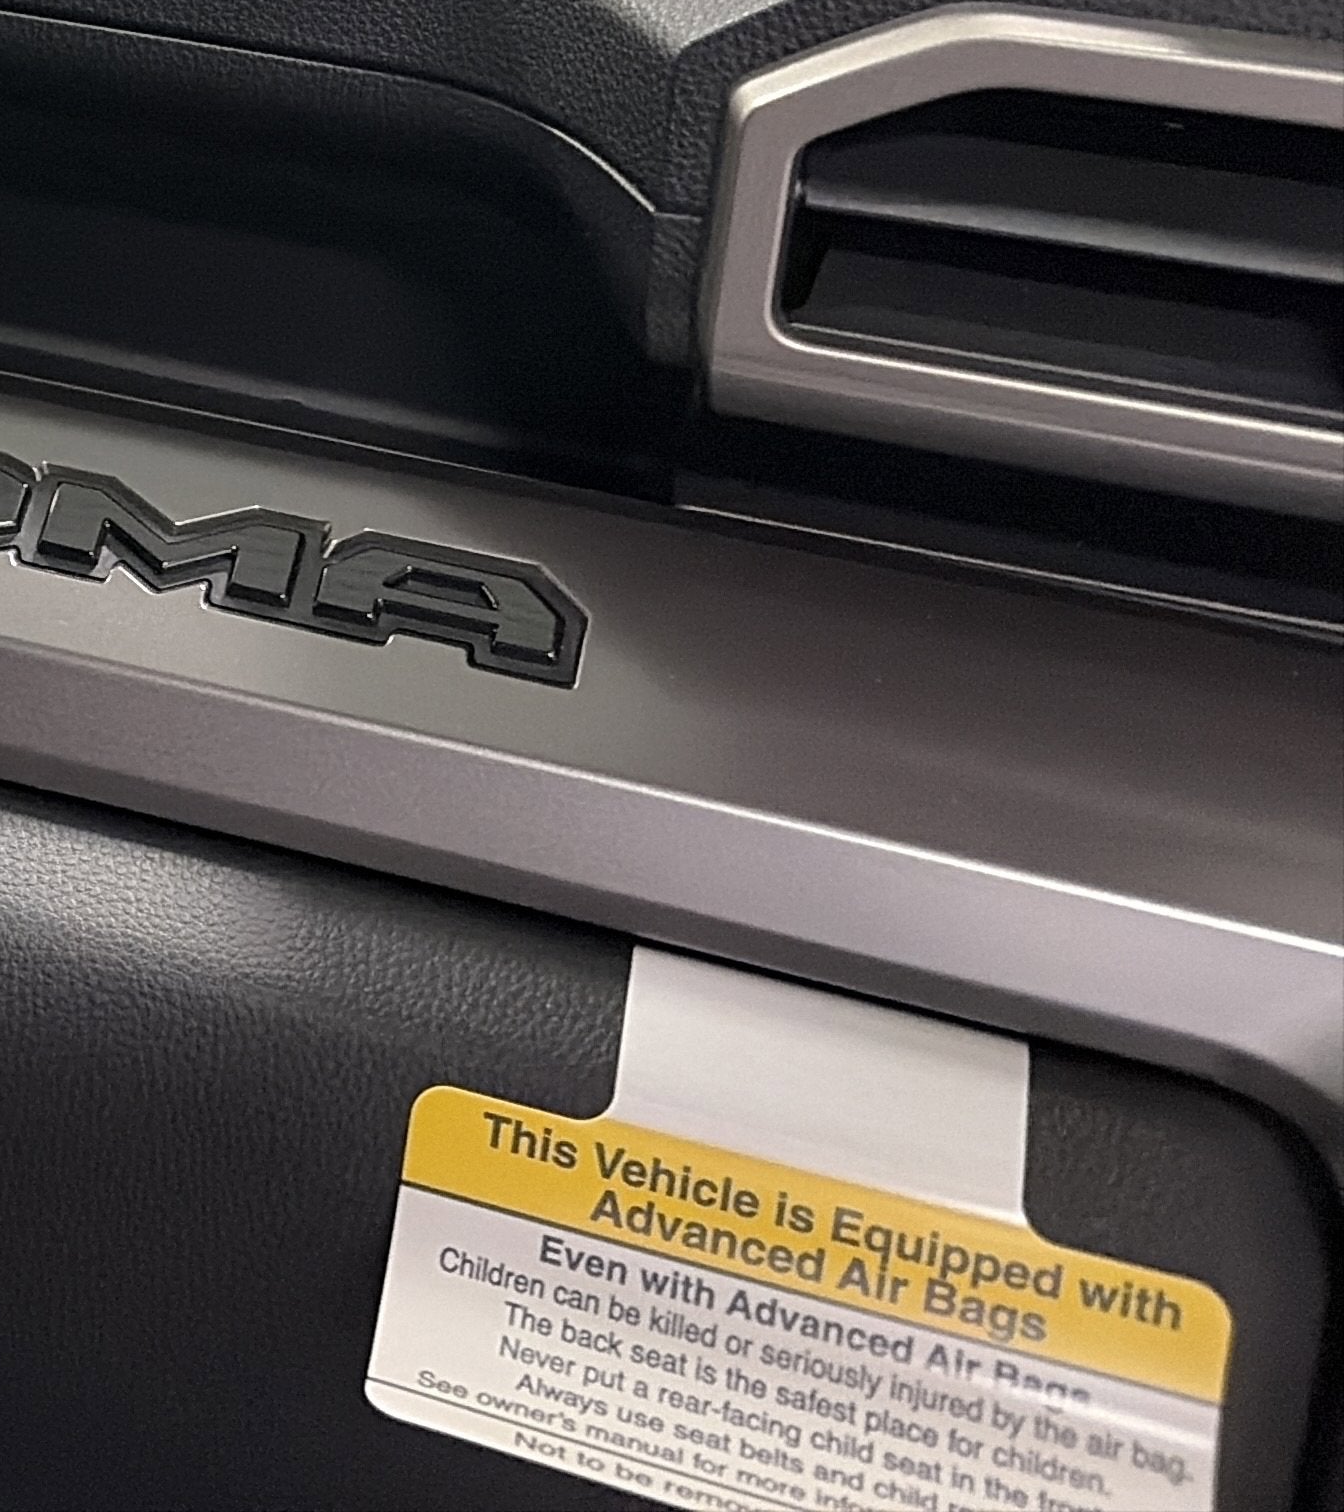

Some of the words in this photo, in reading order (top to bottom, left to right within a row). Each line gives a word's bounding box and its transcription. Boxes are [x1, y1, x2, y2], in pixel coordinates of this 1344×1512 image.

[483, 1110, 578, 1170] This
[595, 1142, 761, 1219] Vehicle
[775, 1191, 815, 1234] is
[830, 1206, 1064, 1299] Equipped
[1079, 1275, 1183, 1331] with
[590, 1189, 826, 1283] Advanced
[838, 1258, 909, 1305] Air
[923, 1278, 1048, 1341] Bags
[439, 1246, 546, 1299] Children
[552, 1285, 601, 1320] can
[609, 1294, 642, 1327] be
[649, 1303, 719, 1349] killed
[725, 1333, 753, 1357] or
[760, 1340, 883, 1400] seriously
[889, 1374, 985, 1423] injured
[991, 1400, 1026, 1440] by
[1033, 1414, 1077, 1449] the
[1086, 1431, 1125, 1460] air
[1131, 1439, 1195, 1486] bag.
[539, 1234, 627, 1285] Even
[641, 1264, 713, 1310] with
[725, 1288, 915, 1364] Advanced
[926, 1344, 983, 1380] Air
[416, 1369, 469, 1400] See
[476, 1391, 577, 1433] owner's
[585, 1423, 684, 1465] manual
[692, 1452, 729, 1478] for
[736, 1468, 806, 1501] more
[499, 1334, 576, 1377] Never
[582, 1363, 625, 1392] put
[632, 1379, 650, 1400] a
[658, 1385, 803, 1449] rear-facing
[810, 1428, 875, 1465] child
[883, 1451, 943, 1485] seat
[950, 1465, 975, 1494] in
[983, 1475, 1030, 1509] the
[505, 1301, 553, 1337] The
[561, 1318, 622, 1358] back
[630, 1343, 688, 1378] seat
[695, 1358, 718, 1386] is
[725, 1366, 768, 1400] the
[775, 1382, 857, 1426] safest
[864, 1409, 940, 1448] place
[947, 1427, 984, 1460] for
[990, 1444, 1110, 1497] children.
[514, 1430, 566, 1461] Not
[576, 1451, 606, 1473] to
[615, 1461, 654, 1487] be
[515, 1372, 609, 1416] Always
[616, 1406, 665, 1433] use
[673, 1421, 732, 1453] seat
[740, 1437, 805, 1475] belts
[813, 1464, 865, 1491] and
[873, 1480, 939, 1512] child
